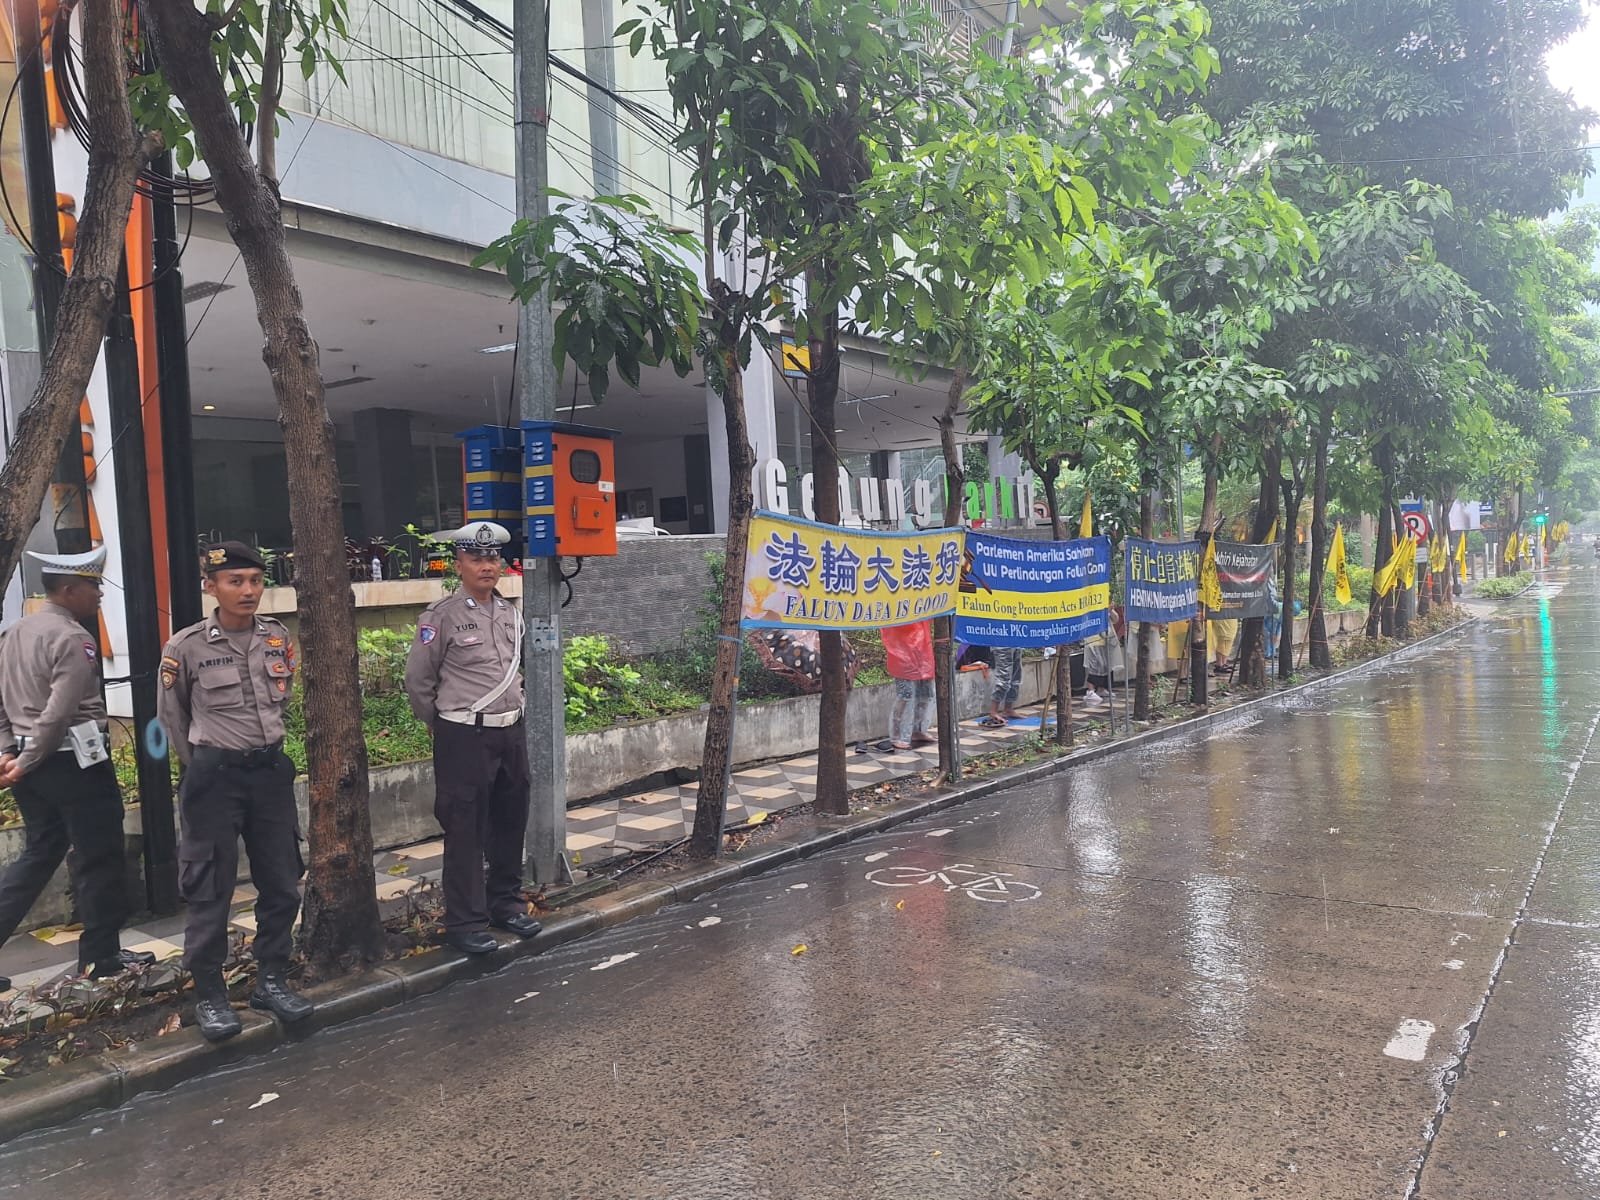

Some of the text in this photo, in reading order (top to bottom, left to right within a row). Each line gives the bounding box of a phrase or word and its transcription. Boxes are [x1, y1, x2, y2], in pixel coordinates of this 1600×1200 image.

[976, 541, 1024, 562] Parlemen
[1026, 549, 1065, 562] Amerika
[765, 531, 961, 594] 法輪大法好
[982, 562, 997, 577] UU
[1001, 565, 1063, 583] Perlindungan
[784, 593, 949, 622] FALUN DAFA IS GOOD
[962, 596, 991, 612] Falun
[993, 600, 1017, 618] Gong
[1018, 602, 1058, 615] Protection
[1059, 600, 1077, 613] Acts
[455, 623, 478, 632] YUDI
[966, 623, 1008, 636] mendesak
[1010, 625, 1029, 637] PKC
[1029, 624, 1069, 640] mengakhiri
[199, 656, 234, 668] ARIFIN
